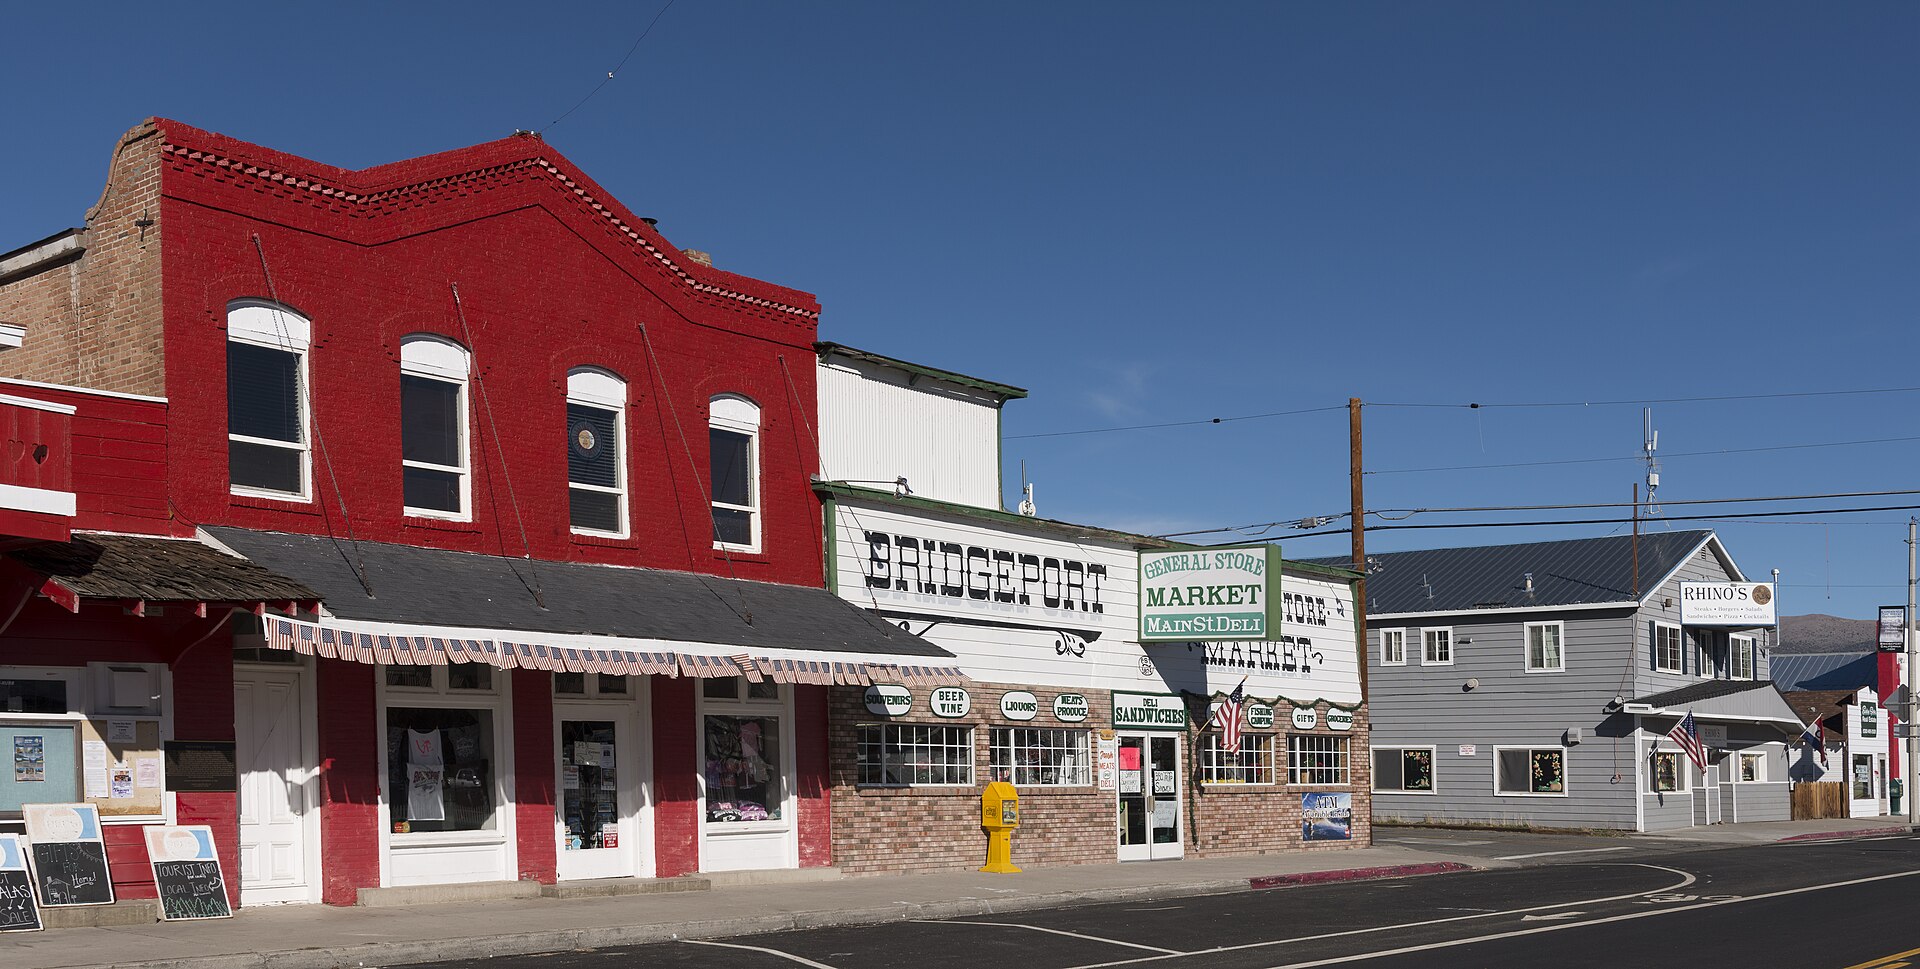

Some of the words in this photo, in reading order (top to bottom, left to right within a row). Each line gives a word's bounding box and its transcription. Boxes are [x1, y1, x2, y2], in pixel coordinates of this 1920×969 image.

[865, 531, 1106, 613] BRIDGEPORT
[1144, 553, 1211, 579] GENERAL
[1215, 553, 1264, 576] STORE
[1146, 584, 1262, 607] MARKET
[1684, 586, 1748, 600] RHINO'S
[1281, 592, 1327, 627] TORE
[1201, 635, 1312, 674] MARKET
[866, 694, 911, 706] SOUVENIRS
[938, 691, 964, 701] BEER
[1060, 696, 1083, 705] MEATS
[940, 703, 963, 713] WINE
[1005, 701, 1036, 712] LIQUORS
[1143, 698, 1158, 708] DELI
[1057, 706, 1087, 716] PRODUCE
[1115, 707, 1184, 723] SANDWICHES
[1251, 708, 1273, 716] FISHING
[1251, 717, 1273, 725] CAMPING
[1296, 714, 1315, 723] GIFTS
[1327, 715, 1353, 723] GROCERIES
[1316, 796, 1337, 809] ATM
[37, 845, 79, 864] GIFTS
[155, 863, 195, 877] TOURIST
[196, 862, 216, 876] INFO
[160, 882, 190, 897] LOCAL
[189, 881, 209, 896] INFO
[0, 906, 36, 924] SALE!
